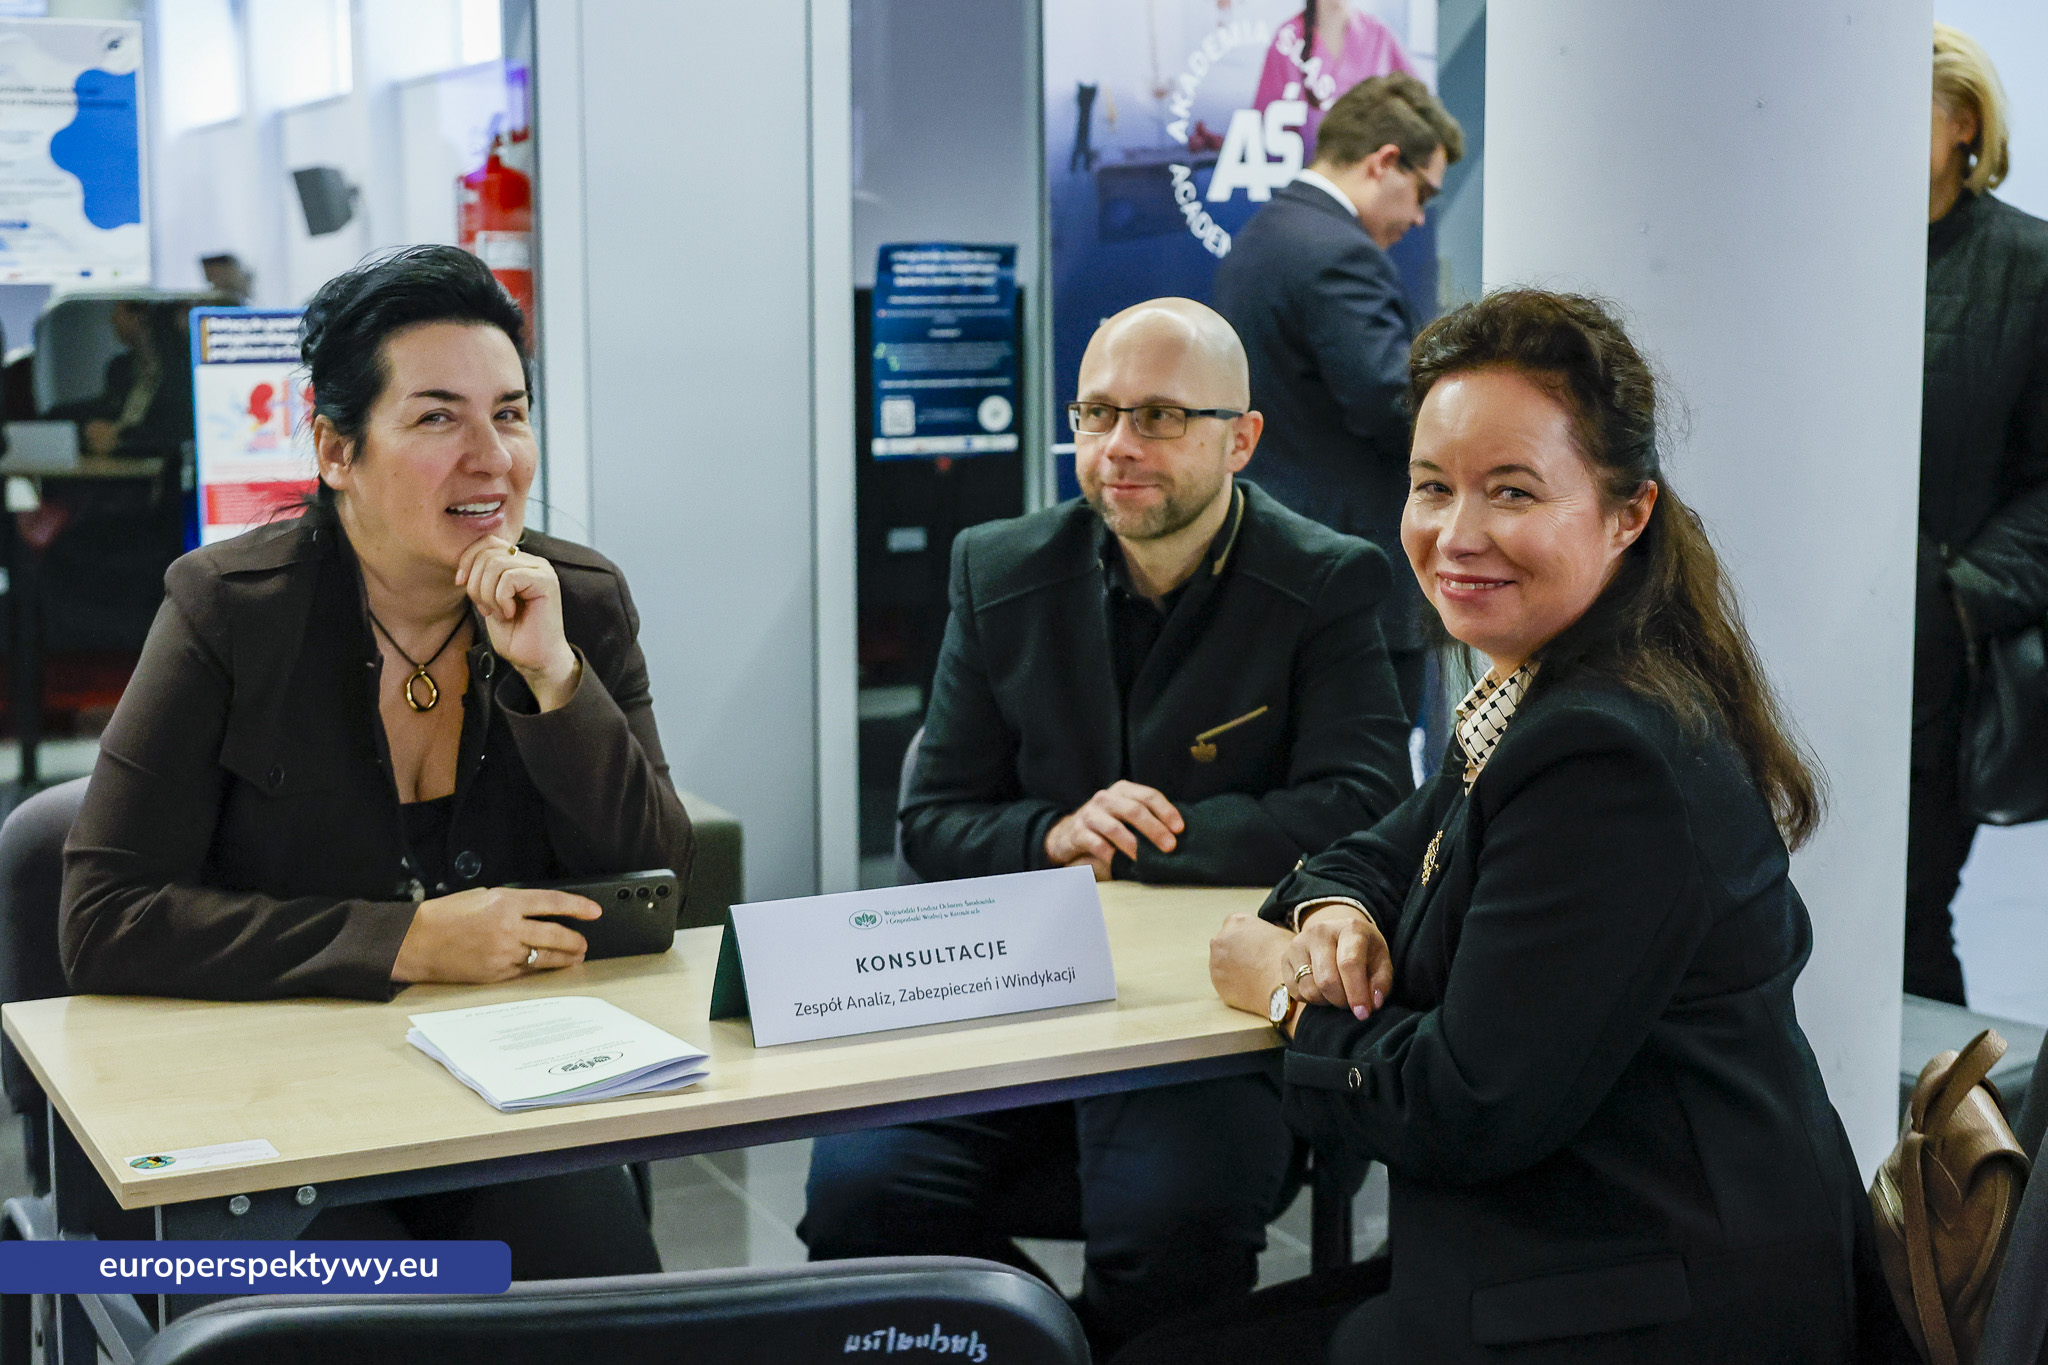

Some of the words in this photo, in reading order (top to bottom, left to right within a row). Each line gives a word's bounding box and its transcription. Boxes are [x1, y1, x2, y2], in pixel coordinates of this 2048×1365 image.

[1206, 81, 1309, 202] AŚ
[855, 940, 1008, 974] KONSULTACJE
[794, 997, 843, 1017] Zespół
[846, 991, 896, 1010] Analiz,
[898, 977, 993, 1003] Zabezpieczeń
[995, 976, 1000, 990] i
[1001, 966, 1077, 989] Windykacji
